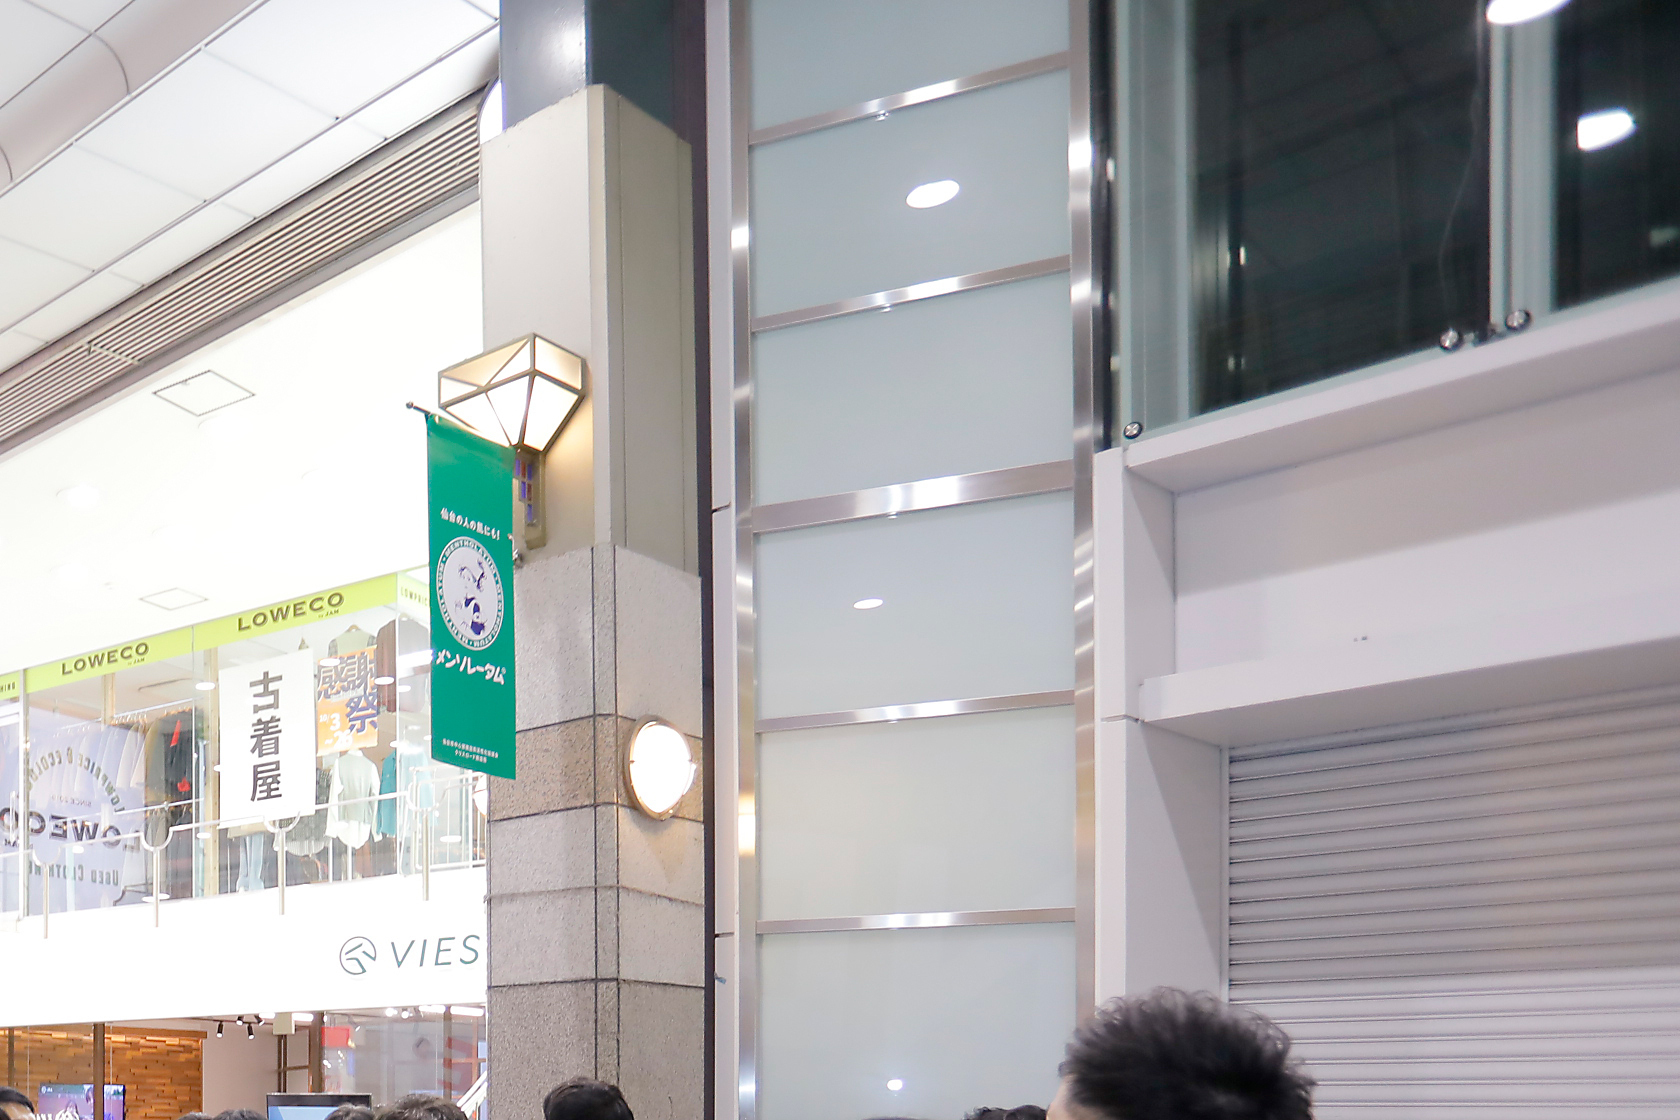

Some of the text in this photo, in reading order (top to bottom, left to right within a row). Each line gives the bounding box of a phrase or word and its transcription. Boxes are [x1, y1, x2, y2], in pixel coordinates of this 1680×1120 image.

[238, 592, 344, 632] LOWECO
[325, 608, 339, 617] JAM
[62, 642, 149, 675] LOWECO
[134, 657, 145, 665] JAM
[436, 649, 505, 685] メンソレータム
[249, 671, 283, 802] 古着屋
[391, 934, 480, 968] VIES
